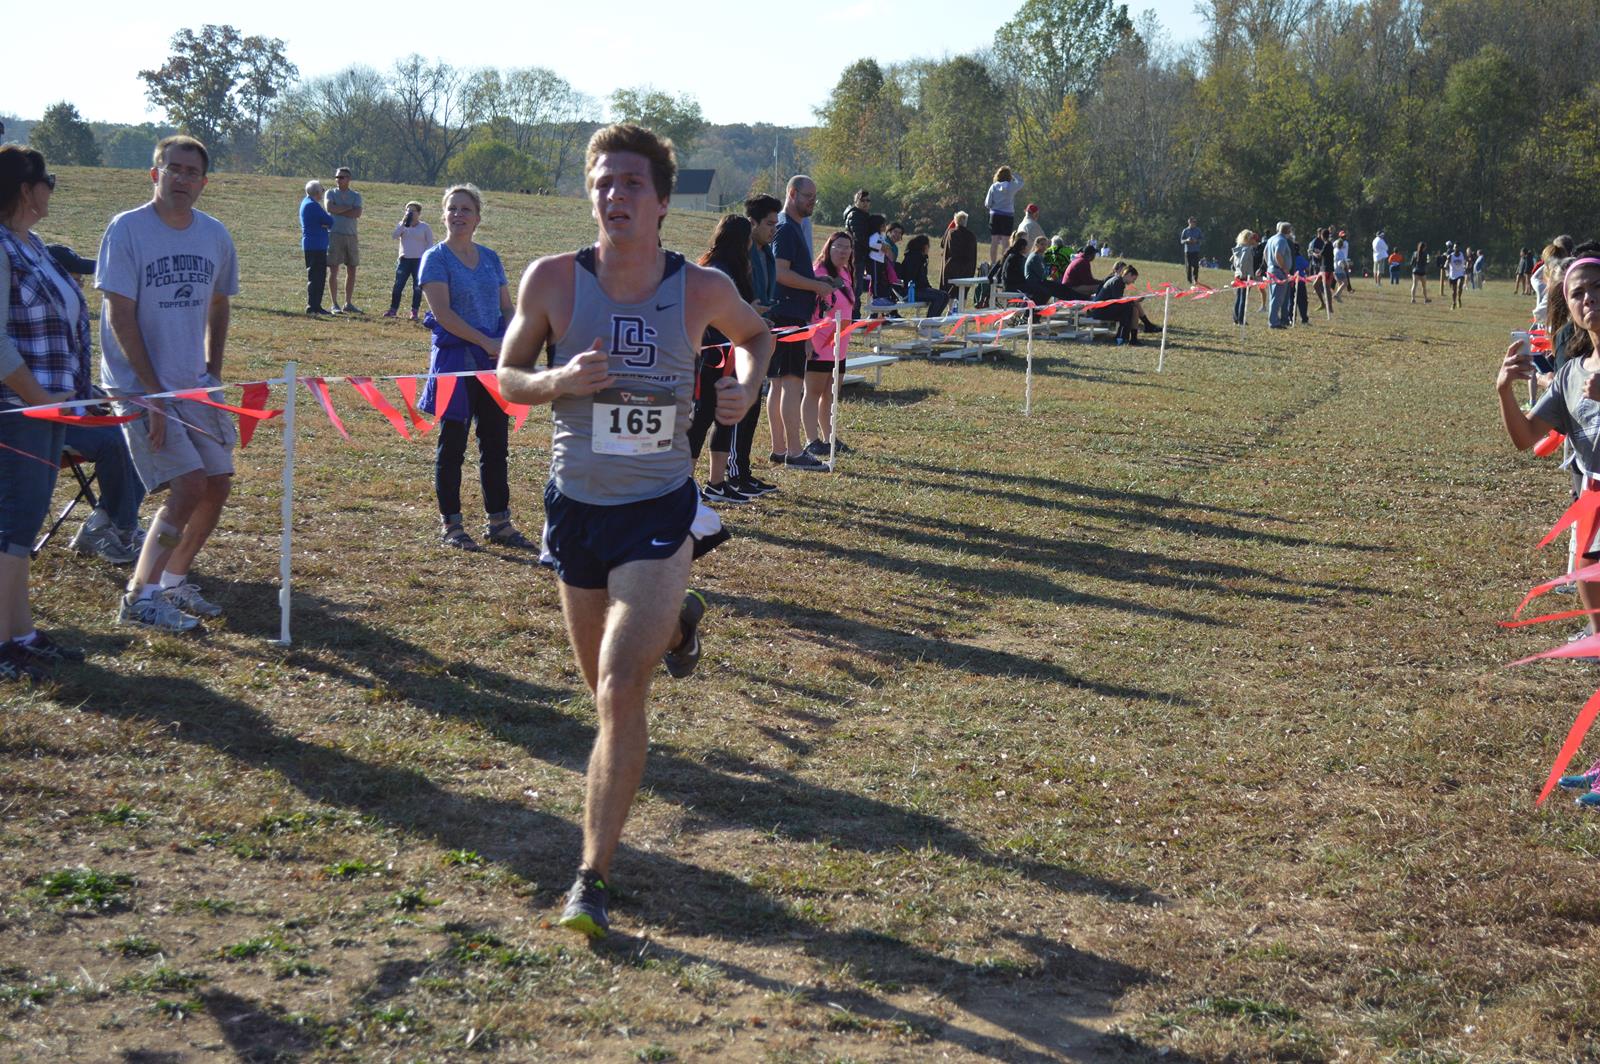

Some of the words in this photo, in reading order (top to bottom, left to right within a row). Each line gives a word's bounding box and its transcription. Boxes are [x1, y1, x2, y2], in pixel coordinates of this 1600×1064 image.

[146, 257, 170, 287] BLUE
[155, 273, 209, 287] COLLEGE
[609, 314, 658, 368] DS
[610, 408, 661, 434] 165
